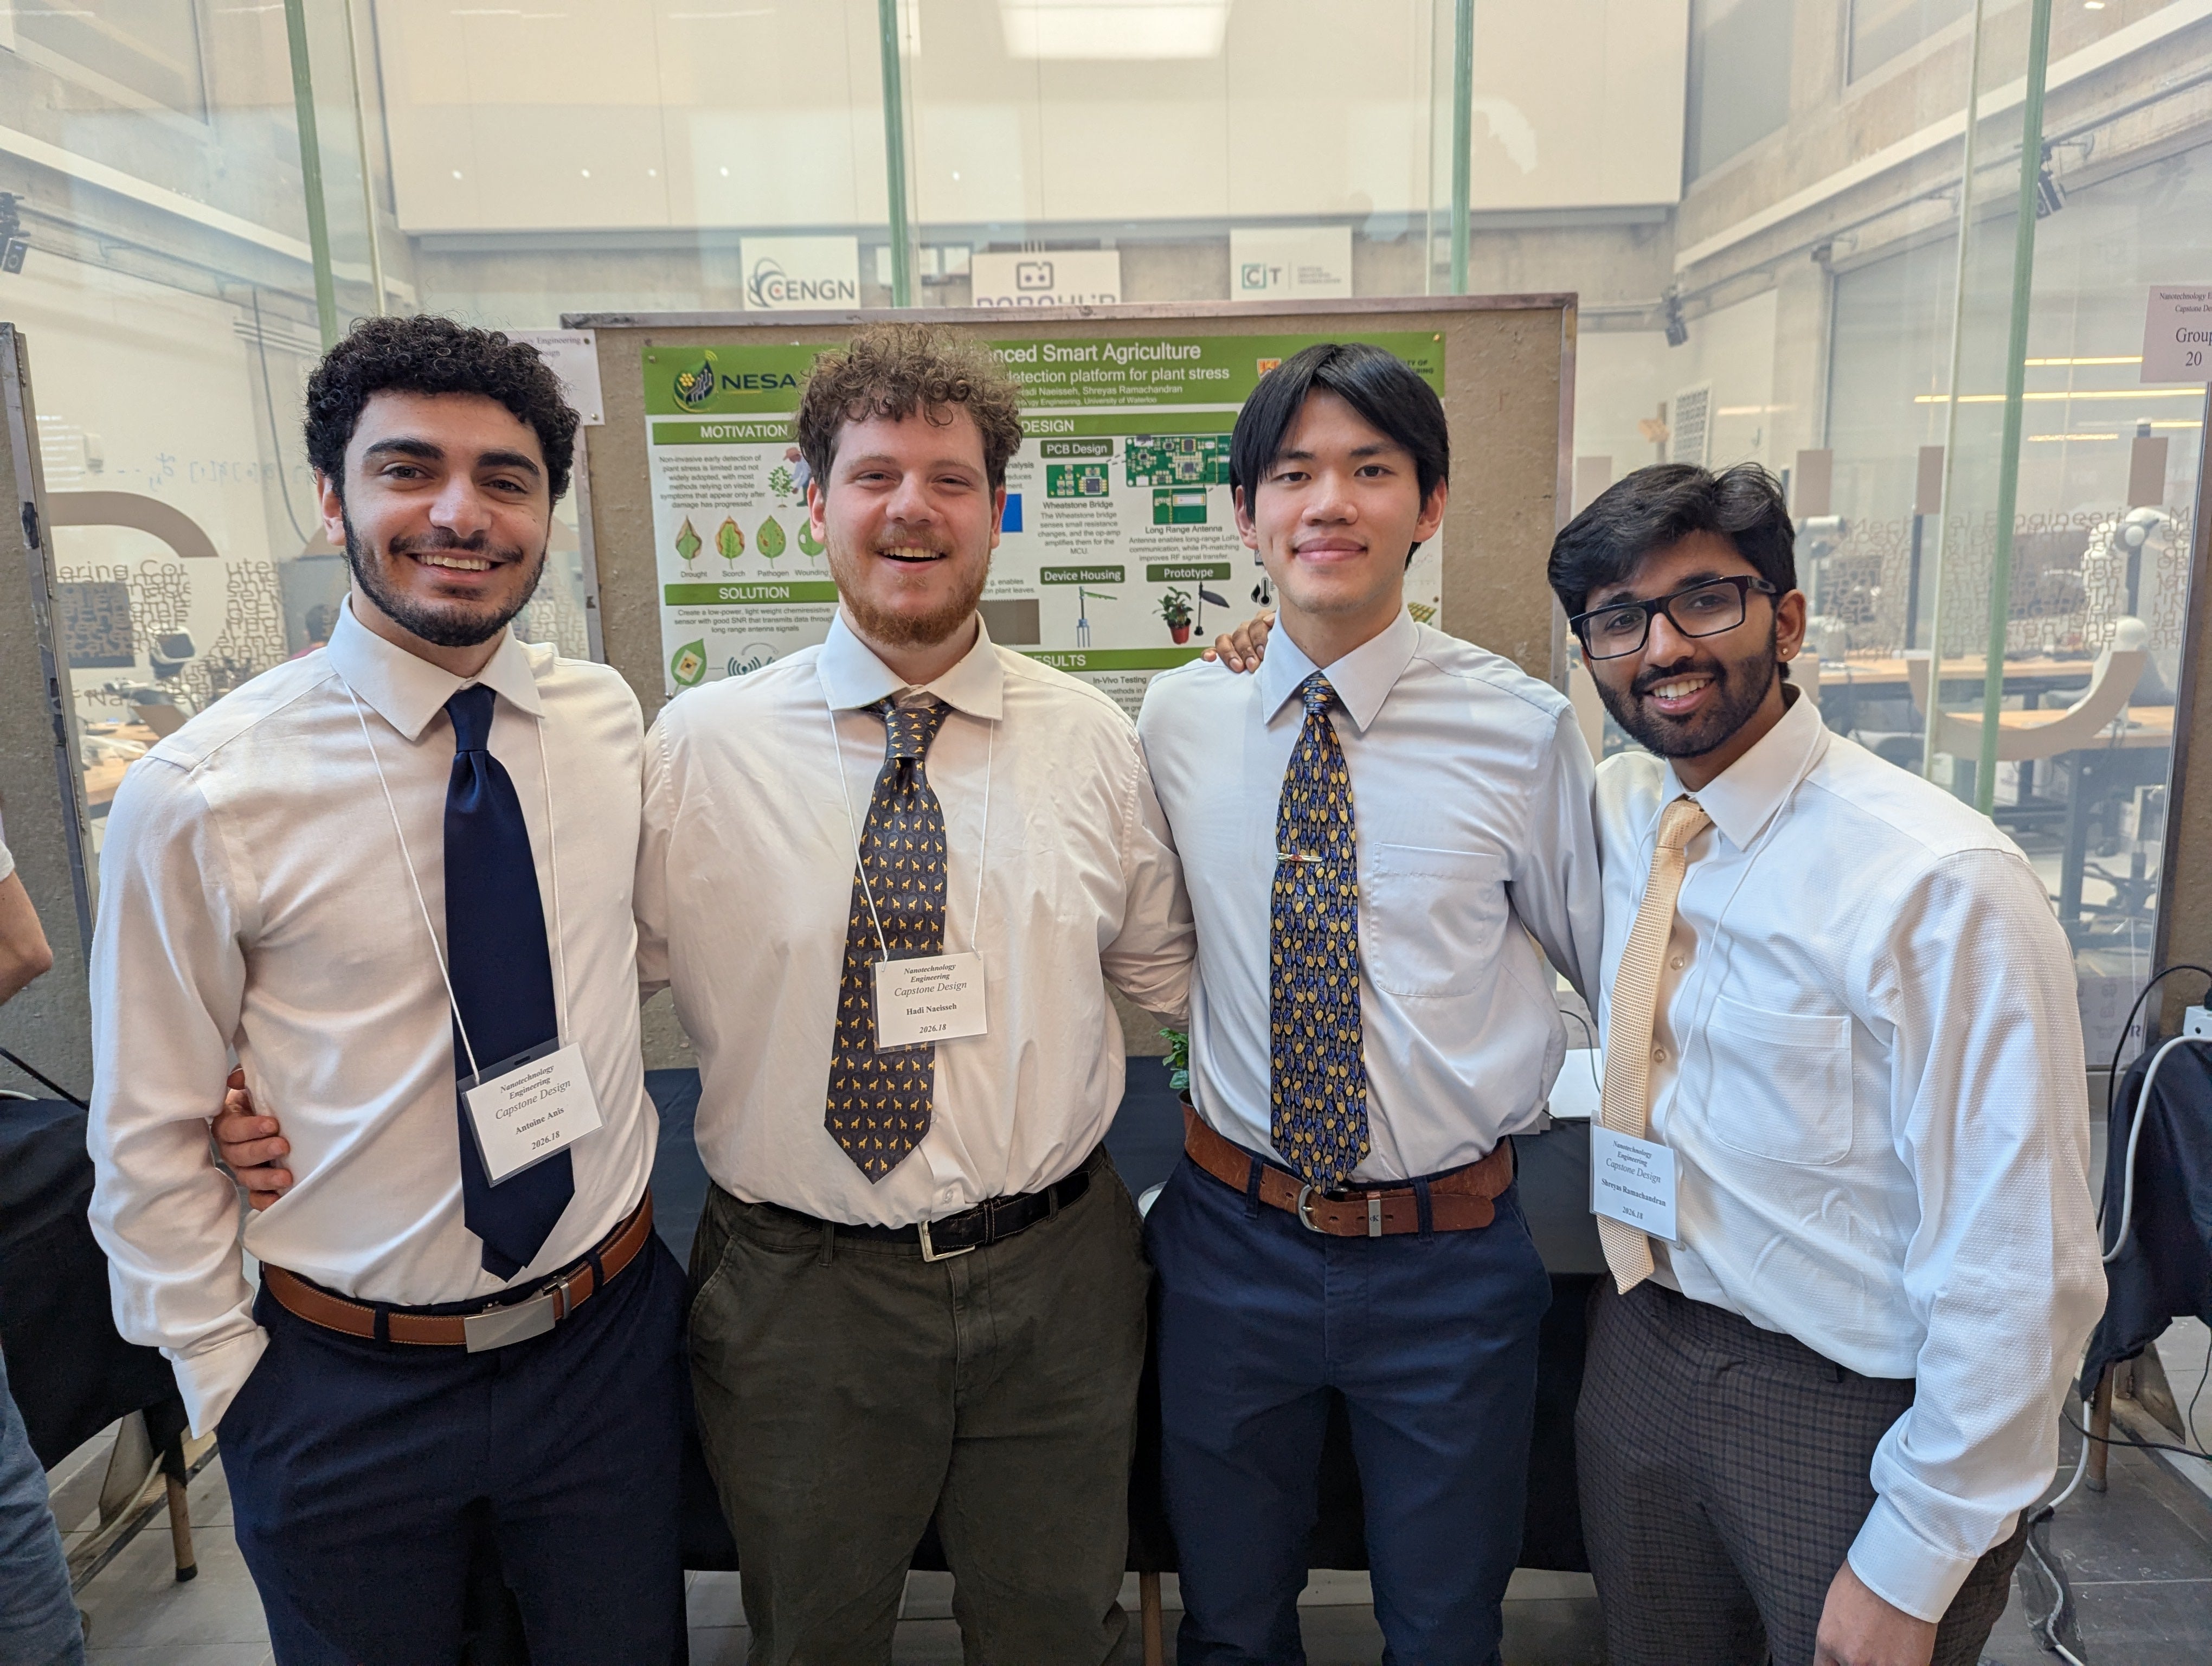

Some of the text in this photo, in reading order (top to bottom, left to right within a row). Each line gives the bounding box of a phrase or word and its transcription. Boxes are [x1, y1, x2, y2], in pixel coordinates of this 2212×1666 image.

[768, 279, 855, 301] CENGN
[2160, 292, 2205, 301] Nanotechnology
[2175, 305, 2202, 313] Capstone
[1043, 343, 1098, 362] Smart
[1102, 342, 1201, 365] Agriculture
[2185, 351, 2202, 367] 20
[722, 373, 797, 389] NESA
[1070, 368, 1125, 384] platform
[1129, 368, 1148, 381] for
[1152, 368, 1185, 383] plant
[1189, 367, 1230, 380] stress
[1083, 386, 1117, 396] Shreyas
[1119, 385, 1182, 395] Ramachandran
[700, 425, 788, 438] MOTIVATION
[1046, 444, 1107, 455] PCB Design
[705, 456, 721, 464] early
[1089, 501, 1114, 509] Bridge
[1145, 527, 1163, 535] Long
[1166, 526, 1190, 534] Range
[757, 570, 789, 578] Pathogen
[1044, 570, 1121, 581] Device Housing
[1163, 568, 1213, 579] Prototype
[719, 586, 790, 599] SOLUTION
[744, 608, 759, 616] light
[761, 608, 782, 616] weight
[713, 617, 730, 625] good
[712, 626, 725, 634] long
[776, 625, 799, 633] signals
[1121, 676, 1147, 684] Testing
[904, 964, 956, 975] Nanotechnology
[910, 973, 950, 983] Engineering
[894, 981, 967, 997] Capstone Design
[906, 1007, 924, 1015] Hadi
[919, 1024, 947, 1033] 2026.18
[500, 1065, 554, 1094] Nanotechnology
[509, 1077, 551, 1100] Engineering
[496, 1080, 571, 1119] Capstone Design
[516, 1107, 564, 1135] Antoine Anis
[531, 1130, 560, 1150] 2026.18
[1613, 1140, 1652, 1158] Nanotechnology
[1617, 1151, 1648, 1167] Engineering
[1606, 1158, 1661, 1184] Capstone Design
[1601, 1178, 1666, 1207] Shreyas Ramachandran
[1622, 1206, 1643, 1220] 2026.18
